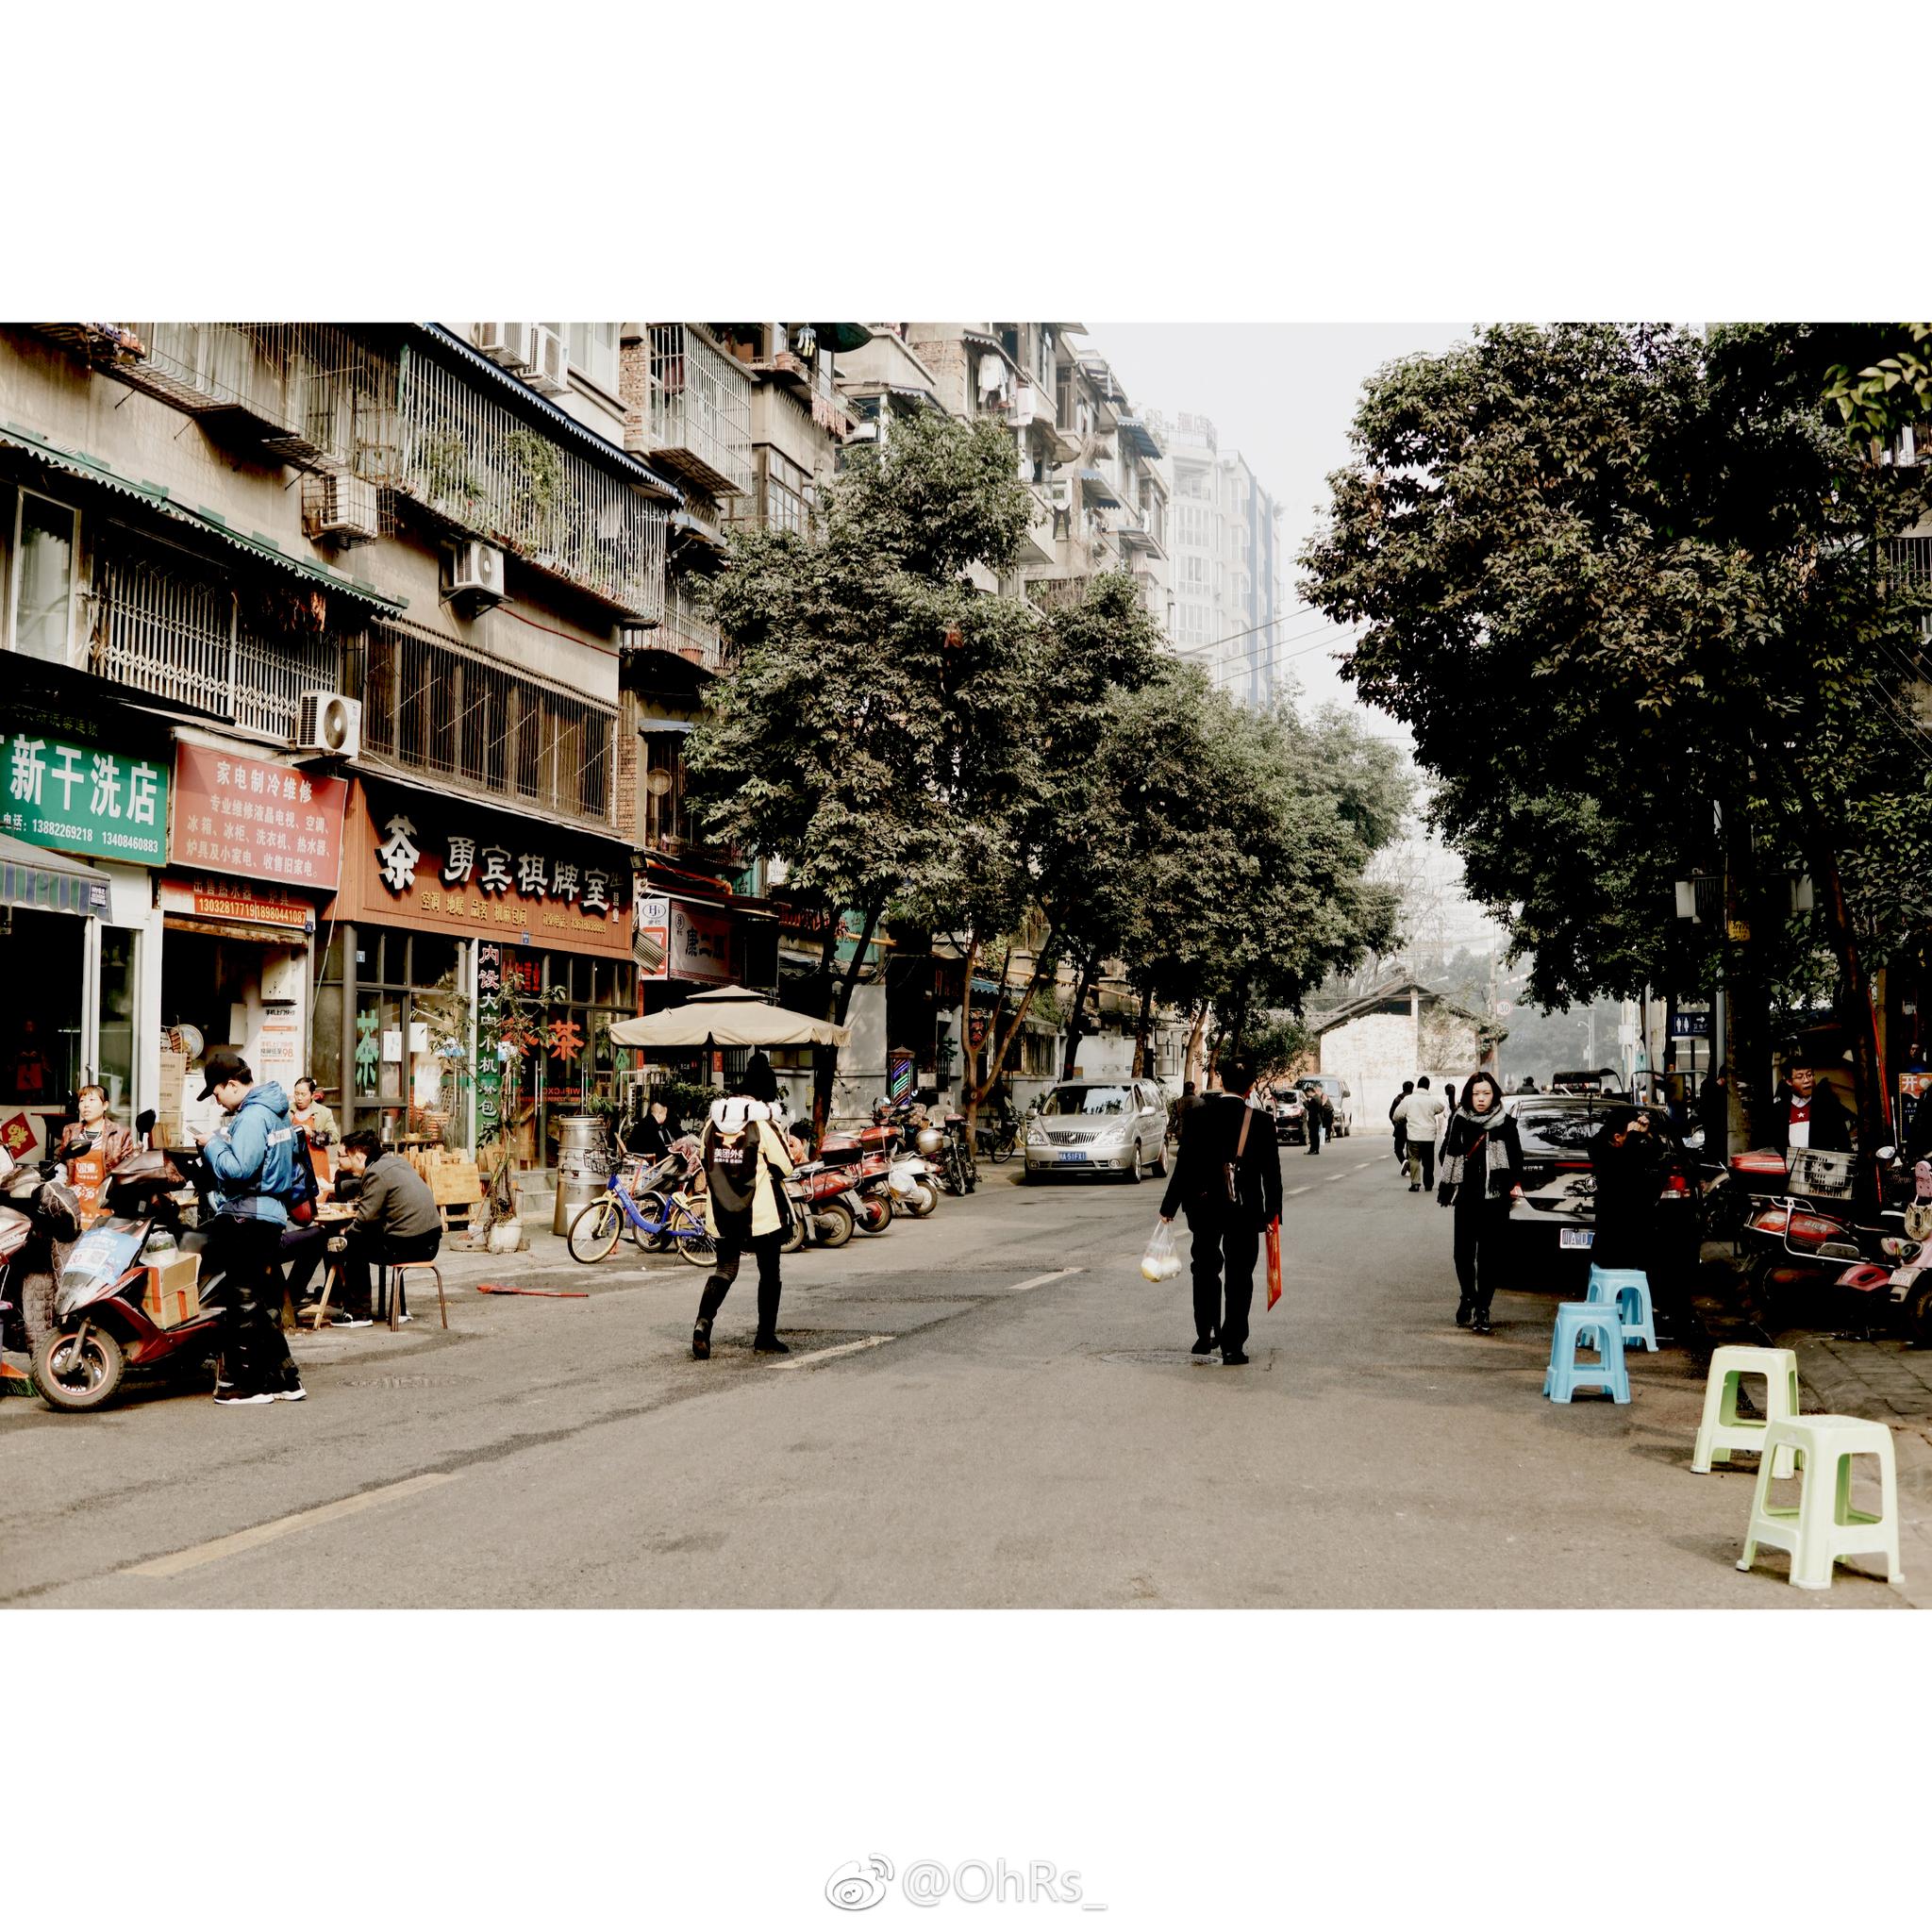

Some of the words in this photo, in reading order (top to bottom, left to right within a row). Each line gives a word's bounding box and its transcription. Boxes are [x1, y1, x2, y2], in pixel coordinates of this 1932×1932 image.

[0, 732, 158, 826] 新干洗店
[216, 760, 312, 804] 家电制冷维修
[32, 818, 93, 842] 13882269218
[102, 831, 158, 853] 13408460883
[379, 813, 421, 890] 茶
[443, 836, 610, 913] 勇宾棋牌室
[198, 897, 255, 917] 13032817719
[256, 904, 307, 924] 18980441087
[1500, 1003, 1509, 1012] 30
[547, 1020, 585, 1061] 茶
[1901, 1075, 1918, 1092] 开
